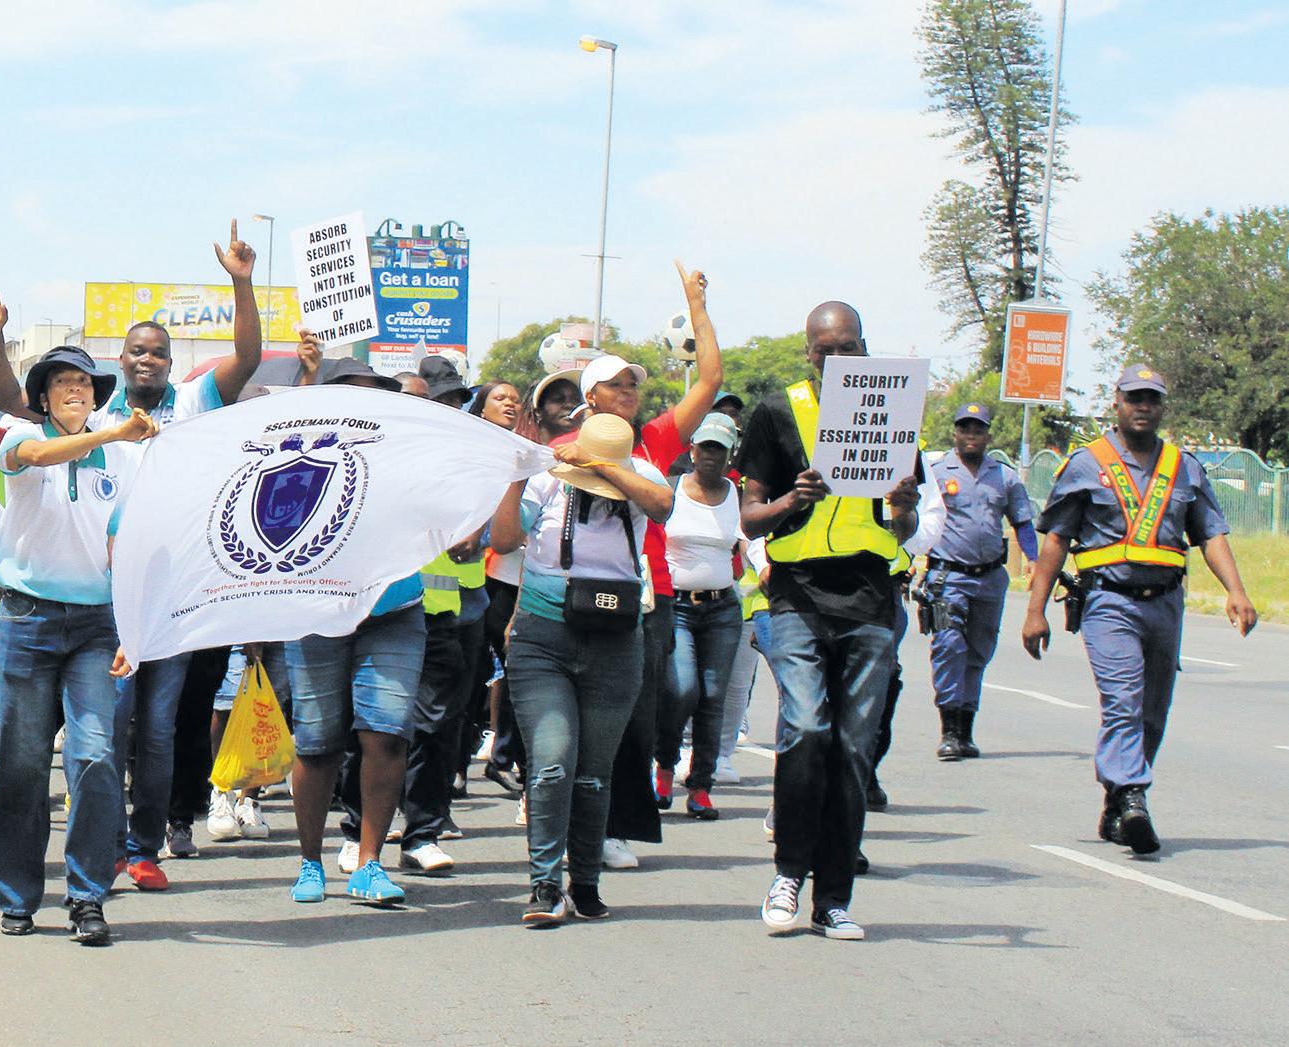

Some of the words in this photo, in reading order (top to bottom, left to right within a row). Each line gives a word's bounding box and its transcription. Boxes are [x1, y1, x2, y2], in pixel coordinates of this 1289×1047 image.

[309, 223, 348, 244] ABSORB
[306, 238, 352, 262] SECURITY
[309, 254, 355, 278] SERVICES
[313, 277, 336, 294] INTO
[337, 271, 356, 287] THE
[379, 271, 408, 286] Get
[411, 275, 421, 286] a
[425, 272, 459, 287] loan
[303, 284, 372, 314] CONSTITUTION
[152, 305, 234, 327] CLEAN
[332, 308, 344, 322] OF
[385, 314, 451, 327] Crusaders
[338, 318, 376, 338] AFRICA.
[842, 374, 909, 389] SECURITY
[860, 393, 886, 408] JOB
[340, 417, 382, 431] FORUM
[852, 412, 868, 426] IS
[869, 412, 889, 427] AN
[818, 429, 888, 445] ESSENTIAL
[891, 430, 916, 445] JOB
[842, 448, 857, 463] IN
[860, 449, 888, 463] OUR
[831, 466, 895, 481] COUNTRY
[1134, 475, 1171, 544] POLICE
[321, 543, 344, 567] DEMAND
[297, 565, 322, 577] FORUM
[250, 580, 269, 588] fight
[283, 578, 316, 586] Security
[220, 590, 262, 602] SECURITY
[317, 589, 358, 598] DEMAND
